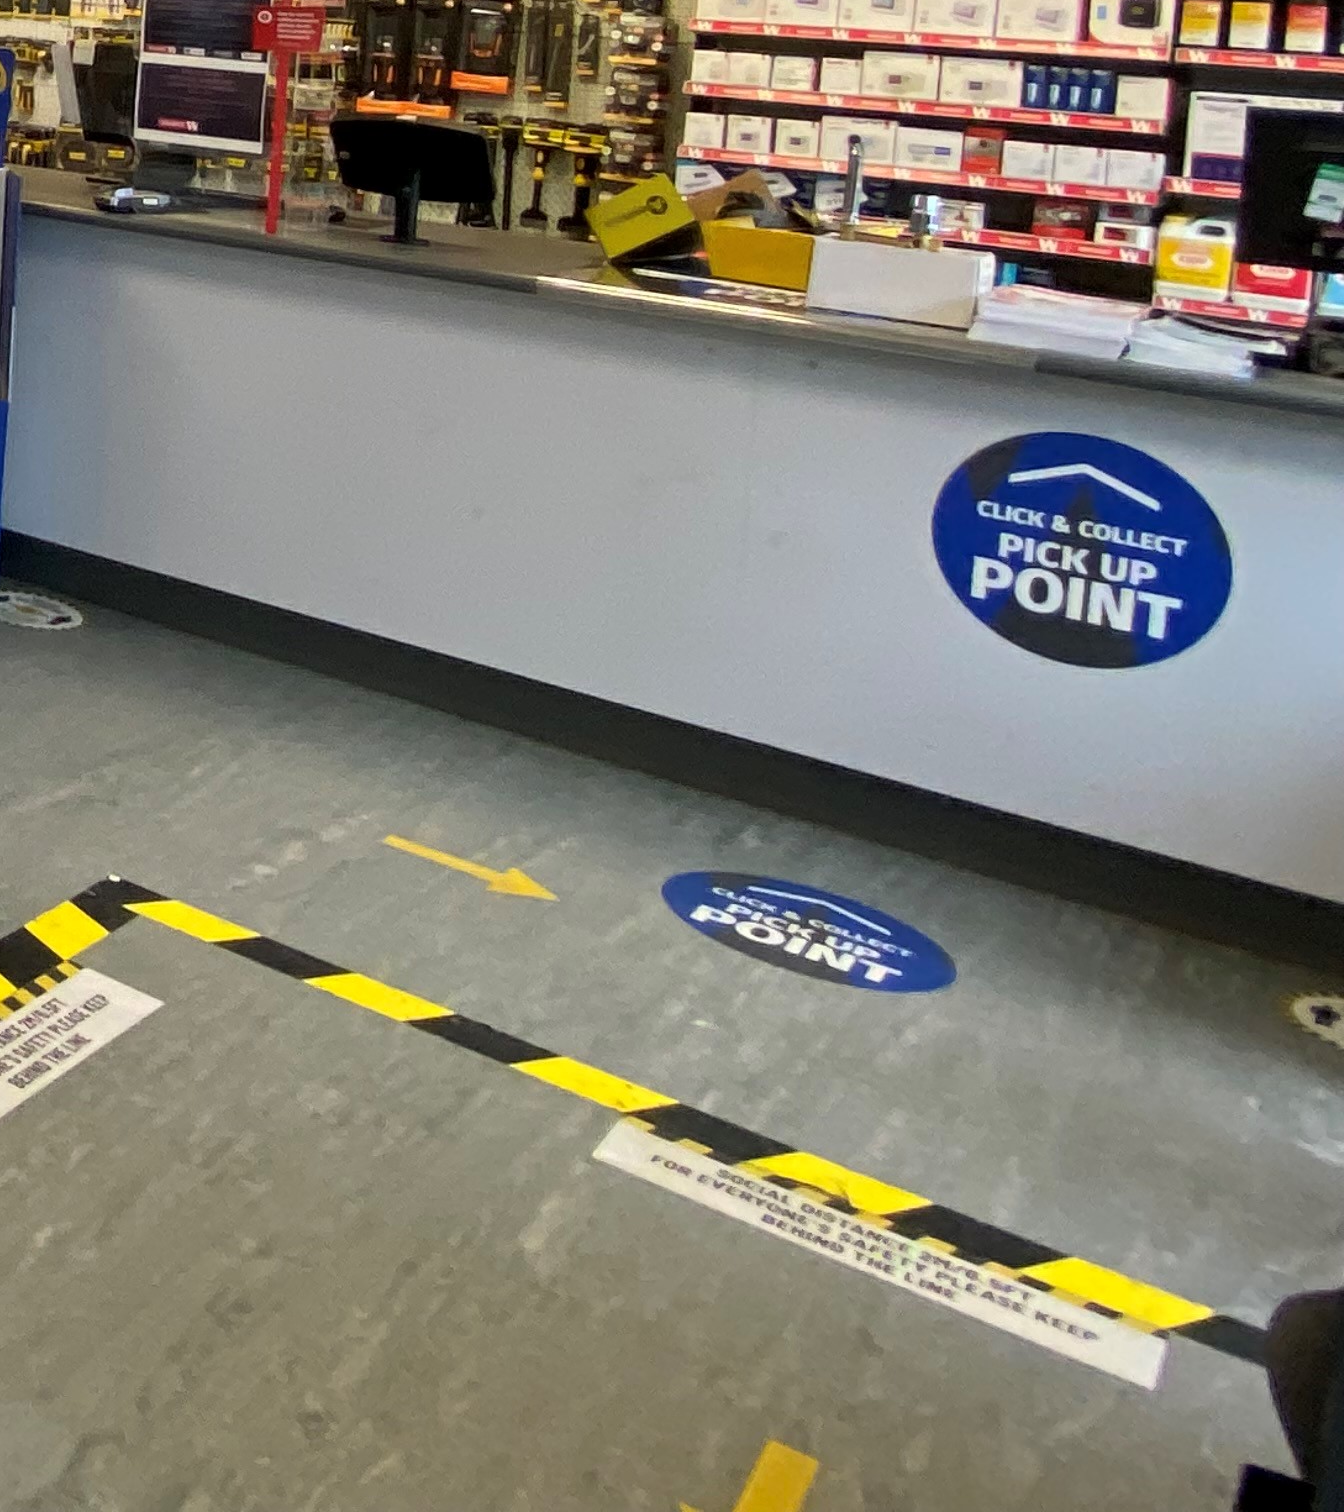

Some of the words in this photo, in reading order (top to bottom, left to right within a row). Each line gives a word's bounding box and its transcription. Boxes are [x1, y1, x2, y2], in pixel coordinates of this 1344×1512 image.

[976, 500, 1045, 529] CLICK
[1051, 514, 1071, 534] &
[1078, 520, 1188, 556] COLLECT
[997, 532, 1090, 575] PICK
[1100, 552, 1157, 586] UP
[970, 556, 1184, 640] POINT
[689, 904, 903, 983] POINT
[712, 887, 778, 912] CLICK
[808, 918, 918, 958] COLLECT
[725, 903, 815, 941] PICK
[824, 936, 882, 959] UP
[11, 1031, 57, 1061] SAFETY
[47, 1009, 89, 1037] PLEASE
[80, 993, 110, 1016] KEEP
[650, 1154, 692, 1176] FOR
[716, 1168, 790, 1205] SOCIAL
